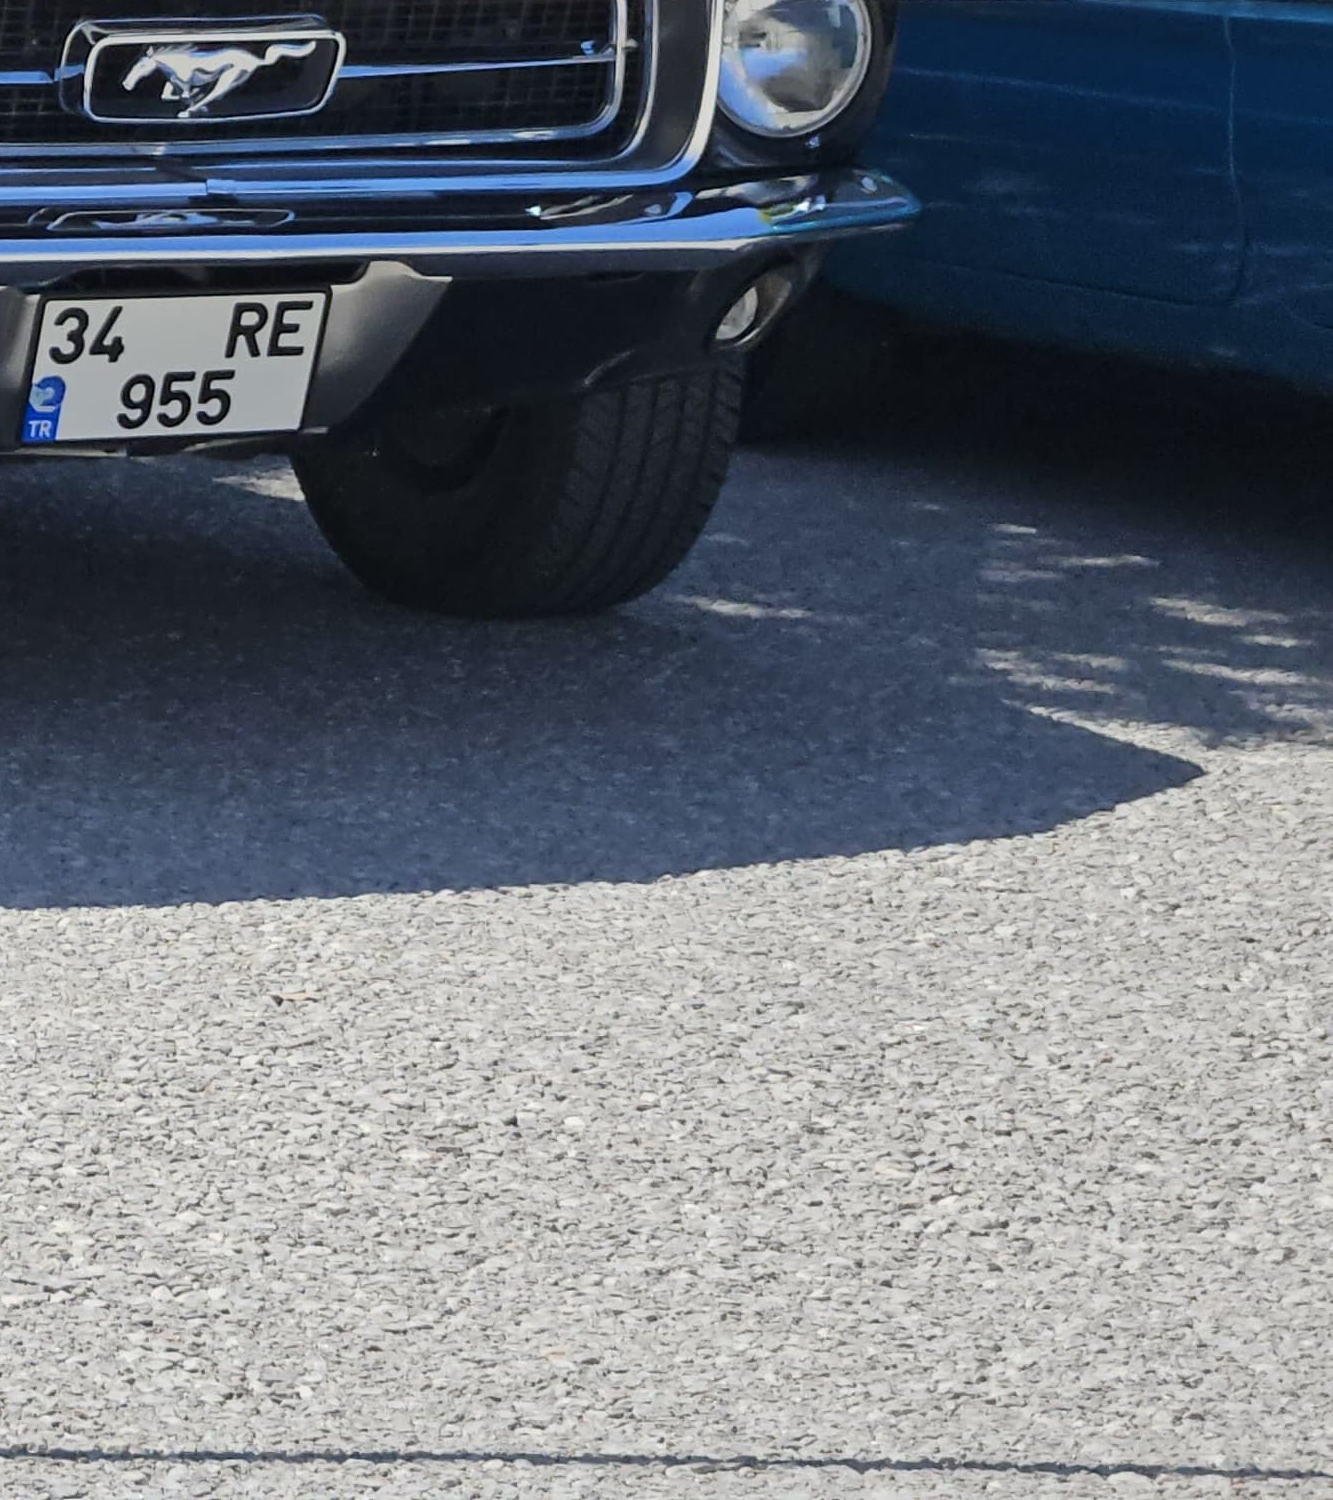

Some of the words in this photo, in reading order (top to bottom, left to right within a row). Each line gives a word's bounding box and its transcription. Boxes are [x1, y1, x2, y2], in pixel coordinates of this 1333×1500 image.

[48, 305, 125, 364] 34
[225, 300, 314, 358] RE
[28, 418, 52, 439] TR
[116, 369, 236, 430] 955
